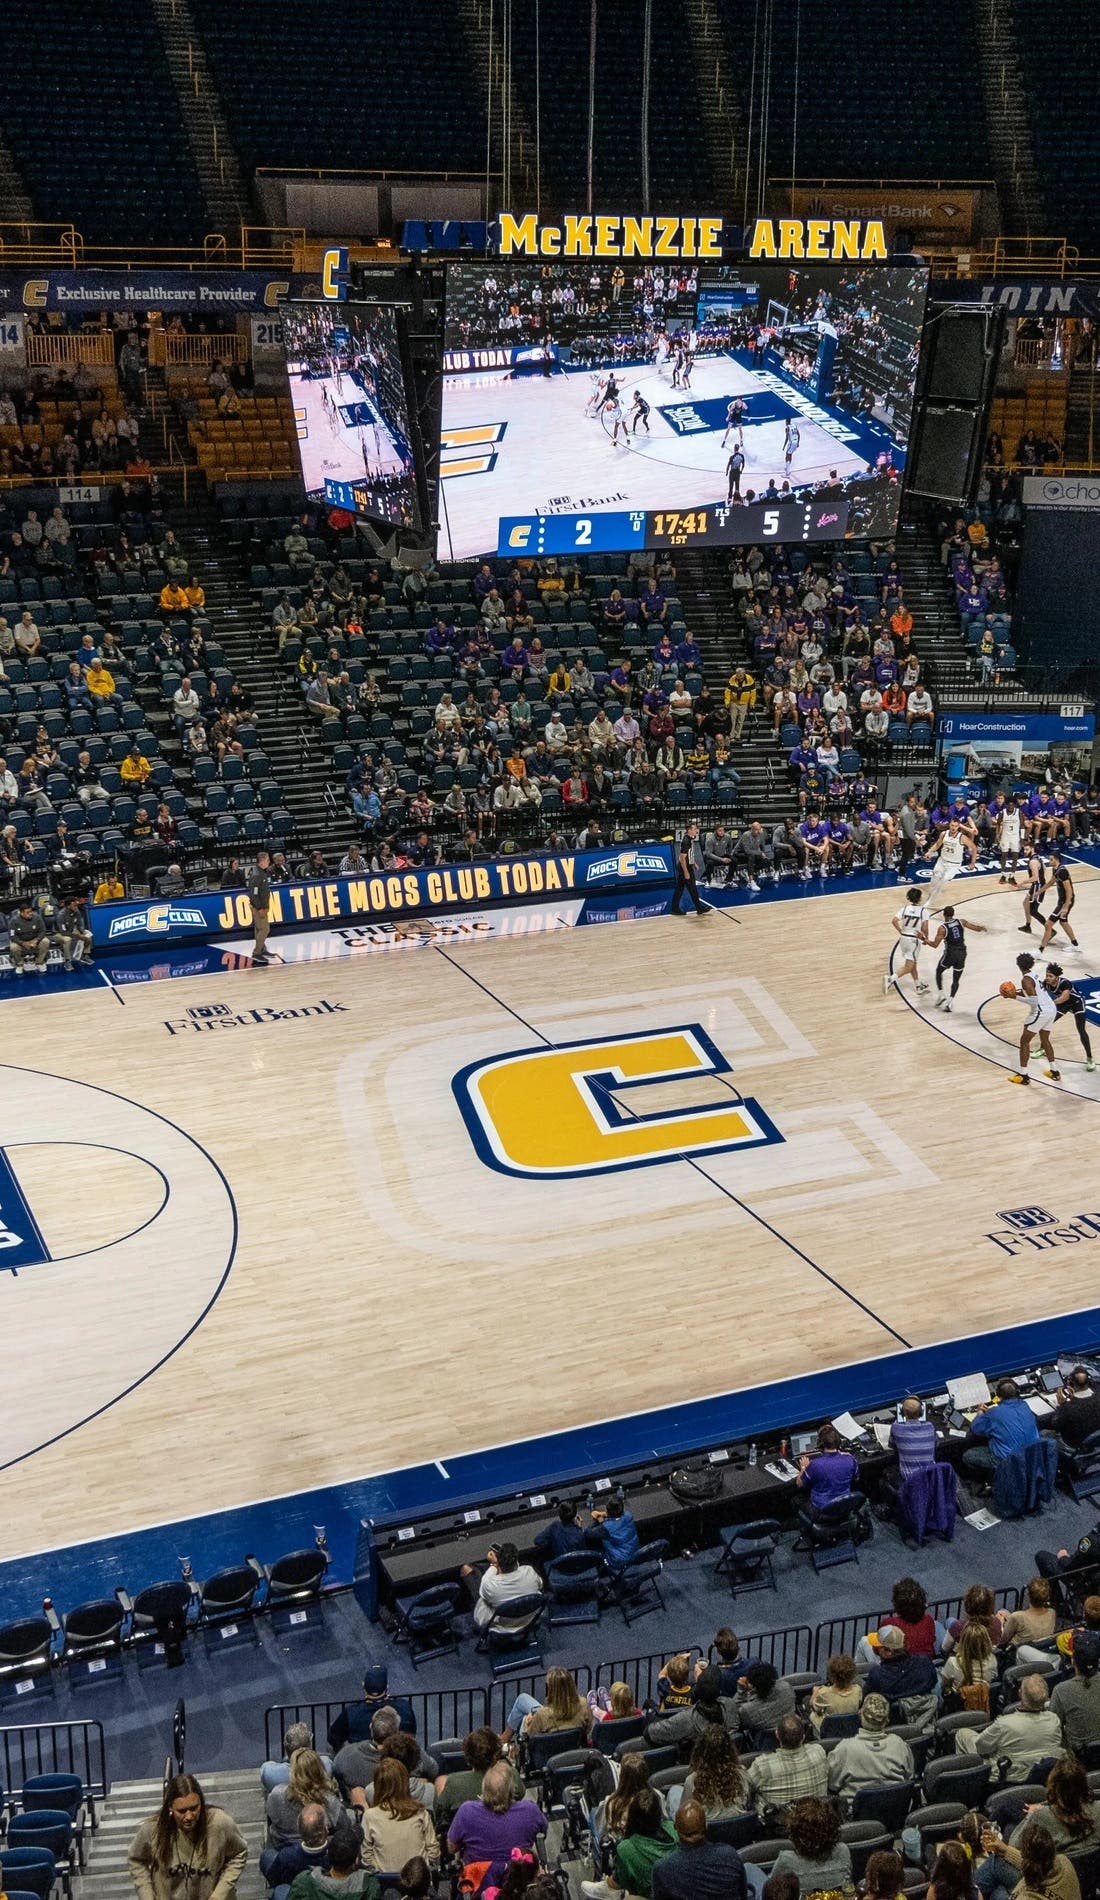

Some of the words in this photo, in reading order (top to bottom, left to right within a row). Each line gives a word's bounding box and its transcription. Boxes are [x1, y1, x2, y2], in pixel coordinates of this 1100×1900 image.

[832, 203, 932, 219] SmartBank
[499, 213, 723, 258] McKENZIE
[749, 219, 888, 259] ARENA
[57, 286, 120, 300] Exclusive
[124, 286, 196, 300] Healthcare
[200, 286, 256, 301] Provider
[473, 350, 512, 367] TODAY
[67, 488, 92, 501] 114
[629, 512, 645, 521] FLS
[714, 508, 731, 517] FLS
[632, 521, 641, 532] 0
[654, 512, 707, 536] 17:41
[719, 516, 725, 527] 1
[762, 510, 780, 536] 5
[574, 519, 593, 546] 2
[670, 535, 688, 545] 1ST
[1062, 706, 1081, 717] 117
[959, 722, 1026, 731] HoarConstruction
[590, 861, 618, 877] MOCS
[636, 857, 663, 869] CLUB
[219, 891, 283, 929] JON
[290, 884, 341, 920] THE
[348, 874, 421, 913] MOCS
[428, 866, 491, 903] CLUB
[496, 857, 576, 895] TODAY
[113, 913, 146, 933] MOCS
[169, 910, 202, 923] CLUB
[904, 915, 919, 928] 77
[160, 1000, 351, 1036] FirstBank
